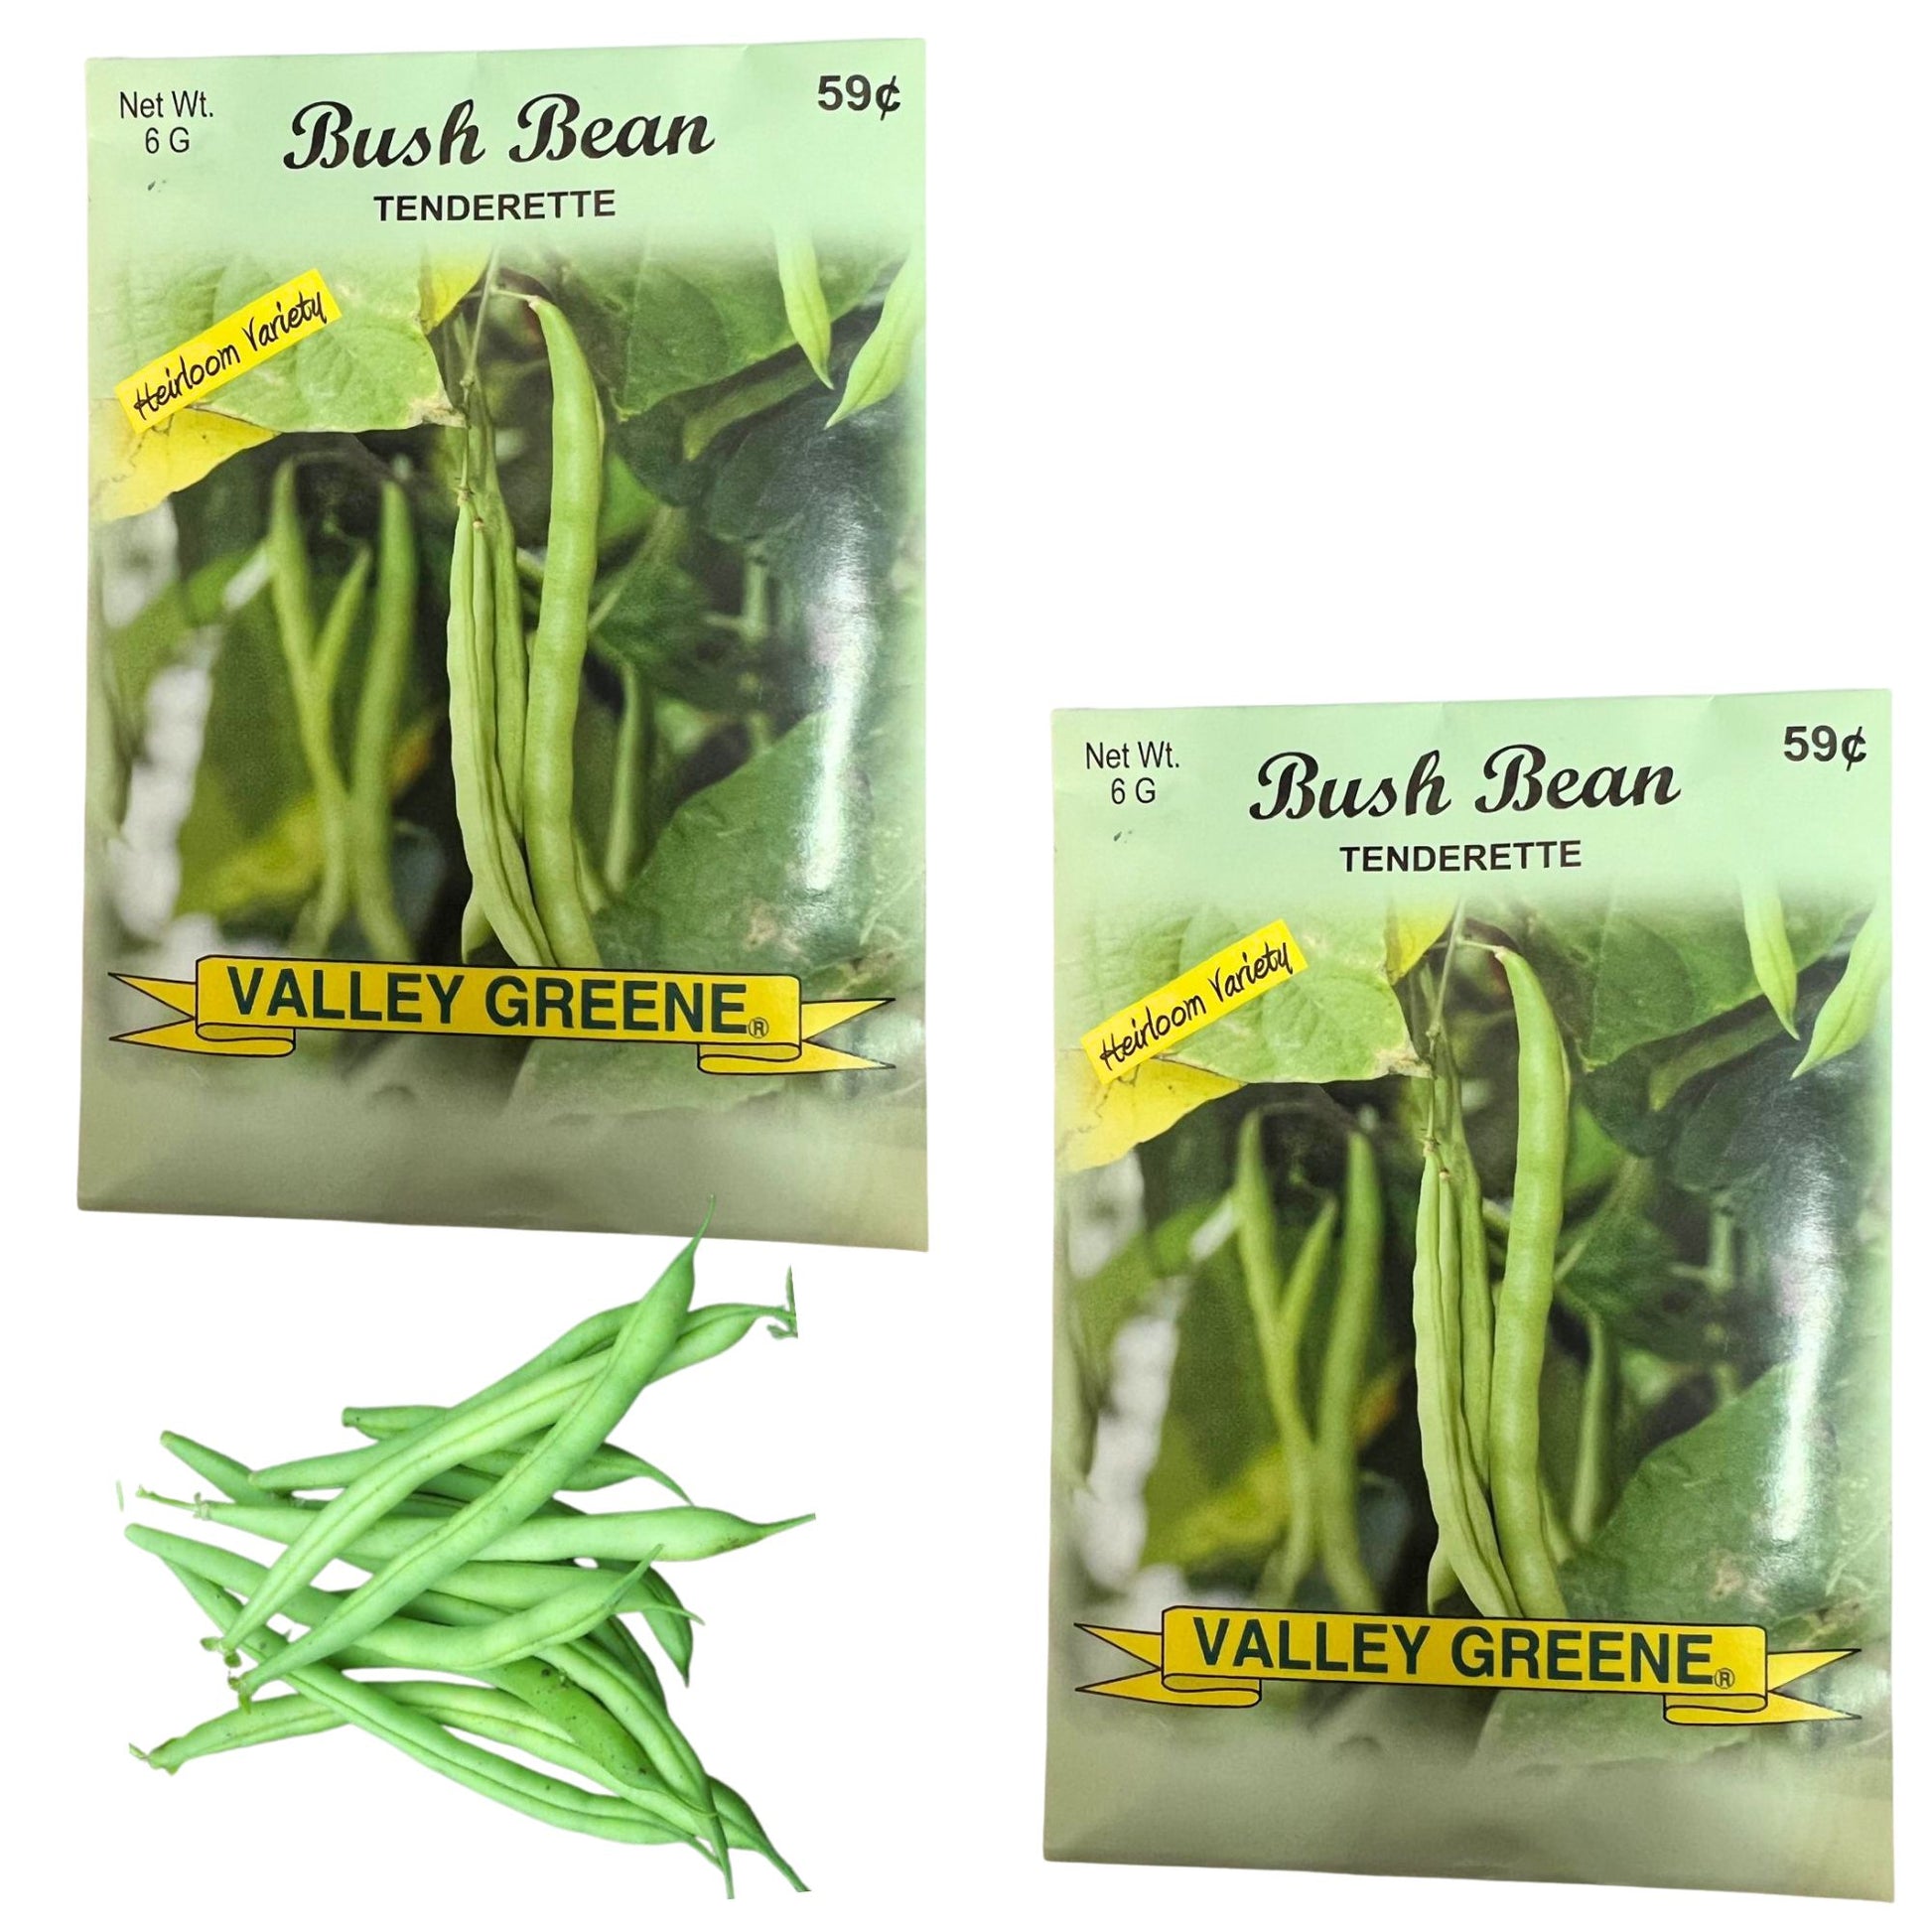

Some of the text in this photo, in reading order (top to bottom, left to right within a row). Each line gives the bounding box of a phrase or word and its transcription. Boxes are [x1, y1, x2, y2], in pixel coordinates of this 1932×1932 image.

[119, 89, 213, 119] Net Wt.
[817, 73, 901, 121] 59¢
[145, 126, 190, 155] 6 G
[282, 92, 716, 170] Bush Bean
[372, 189, 616, 221] TENDERETTE
[133, 291, 328, 421] Heirloom Variety
[1085, 740, 1179, 769] Net Wt.
[1783, 724, 1867, 771] 59¢
[1111, 776, 1156, 805] 6 G
[1248, 743, 1682, 820] Bush Bean
[1338, 839, 1582, 872] TENDERETTE
[225, 964, 466, 1026] VALLEY
[1099, 941, 1294, 1071] Heirloom Variety
[1191, 1614, 1432, 1676] VALLEY
